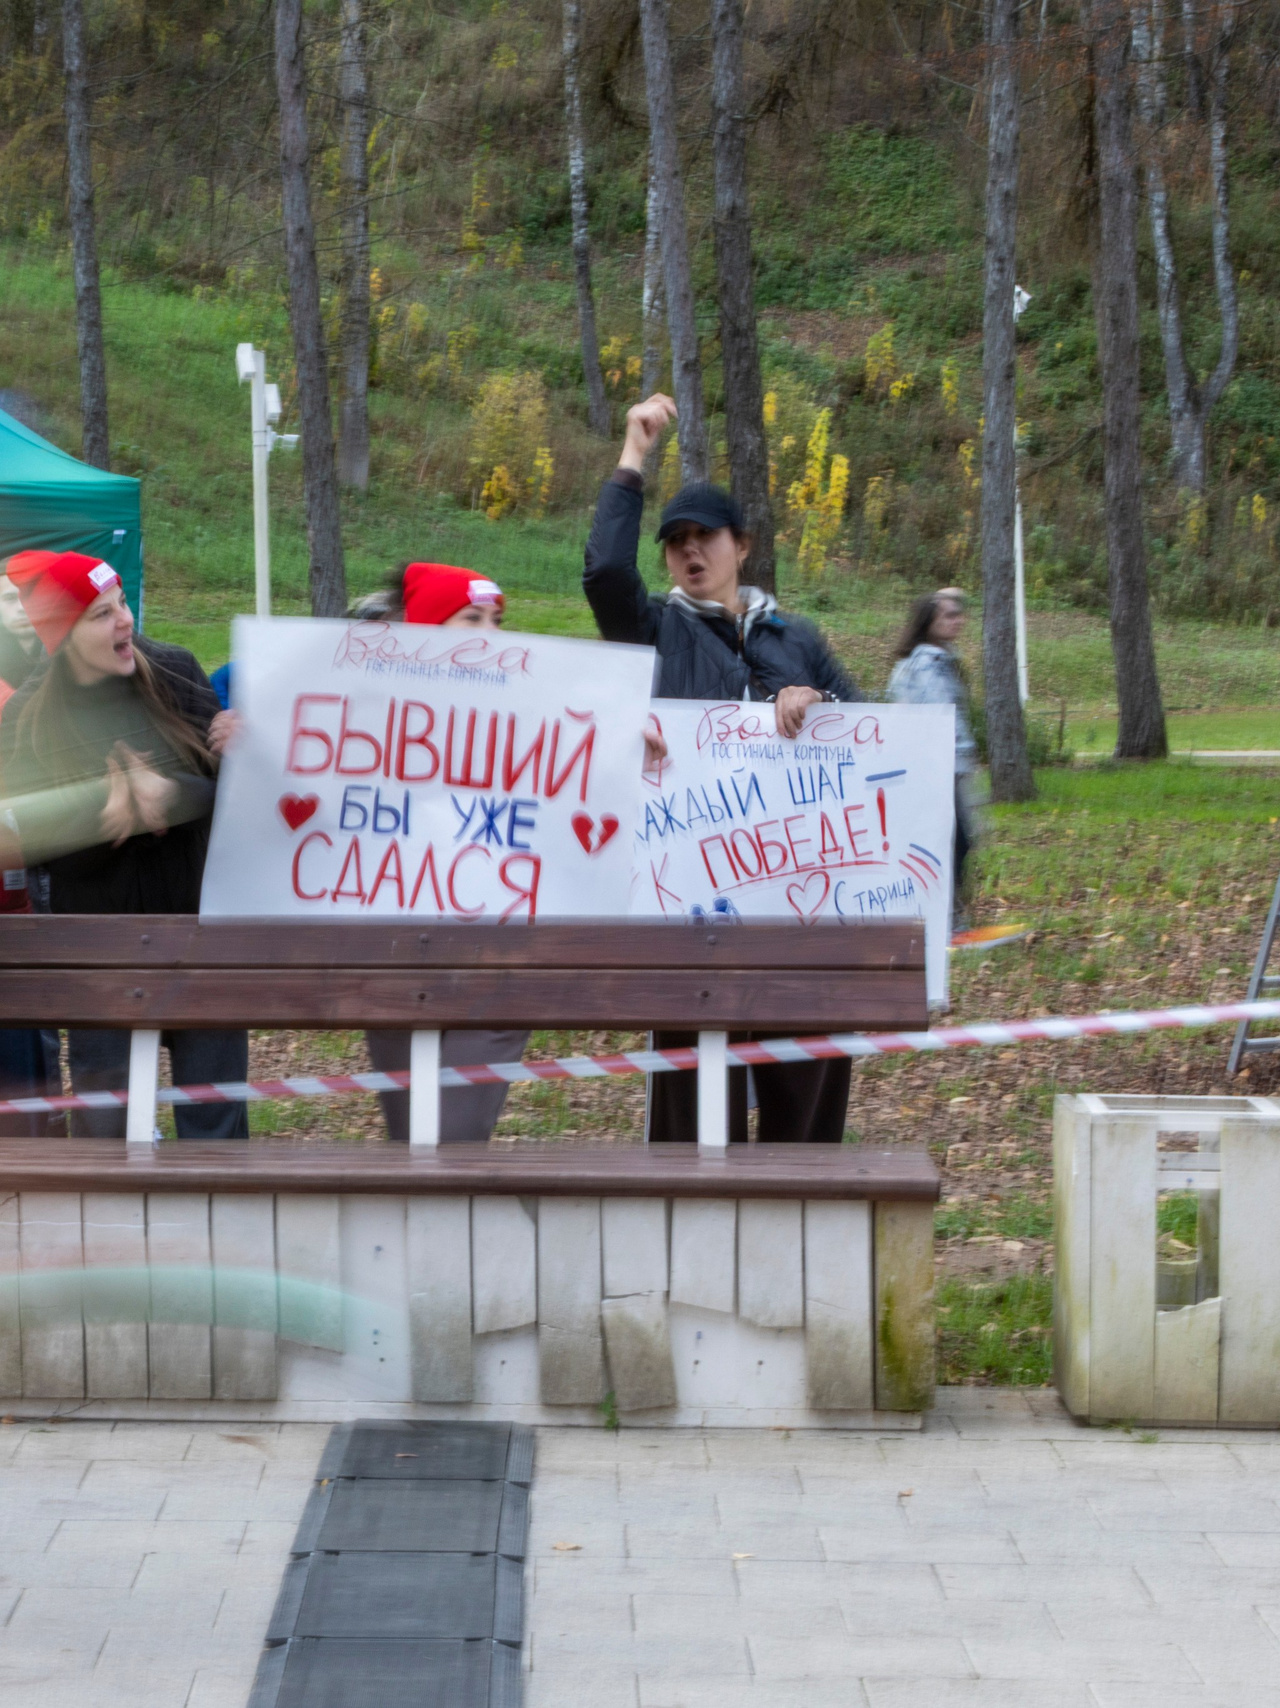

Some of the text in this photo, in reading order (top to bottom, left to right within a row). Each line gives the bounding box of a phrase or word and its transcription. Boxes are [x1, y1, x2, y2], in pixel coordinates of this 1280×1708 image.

[288, 692, 600, 802] БЫВШИЙ
[339, 784, 541, 850] БЫ УЖЕ
[635, 768, 766, 842] АЖДЫЙ
[787, 762, 855, 805] ШАГ
[291, 830, 543, 925] СДАЛСЯ
[650, 786, 891, 920] К ПОБЕДЕ!
